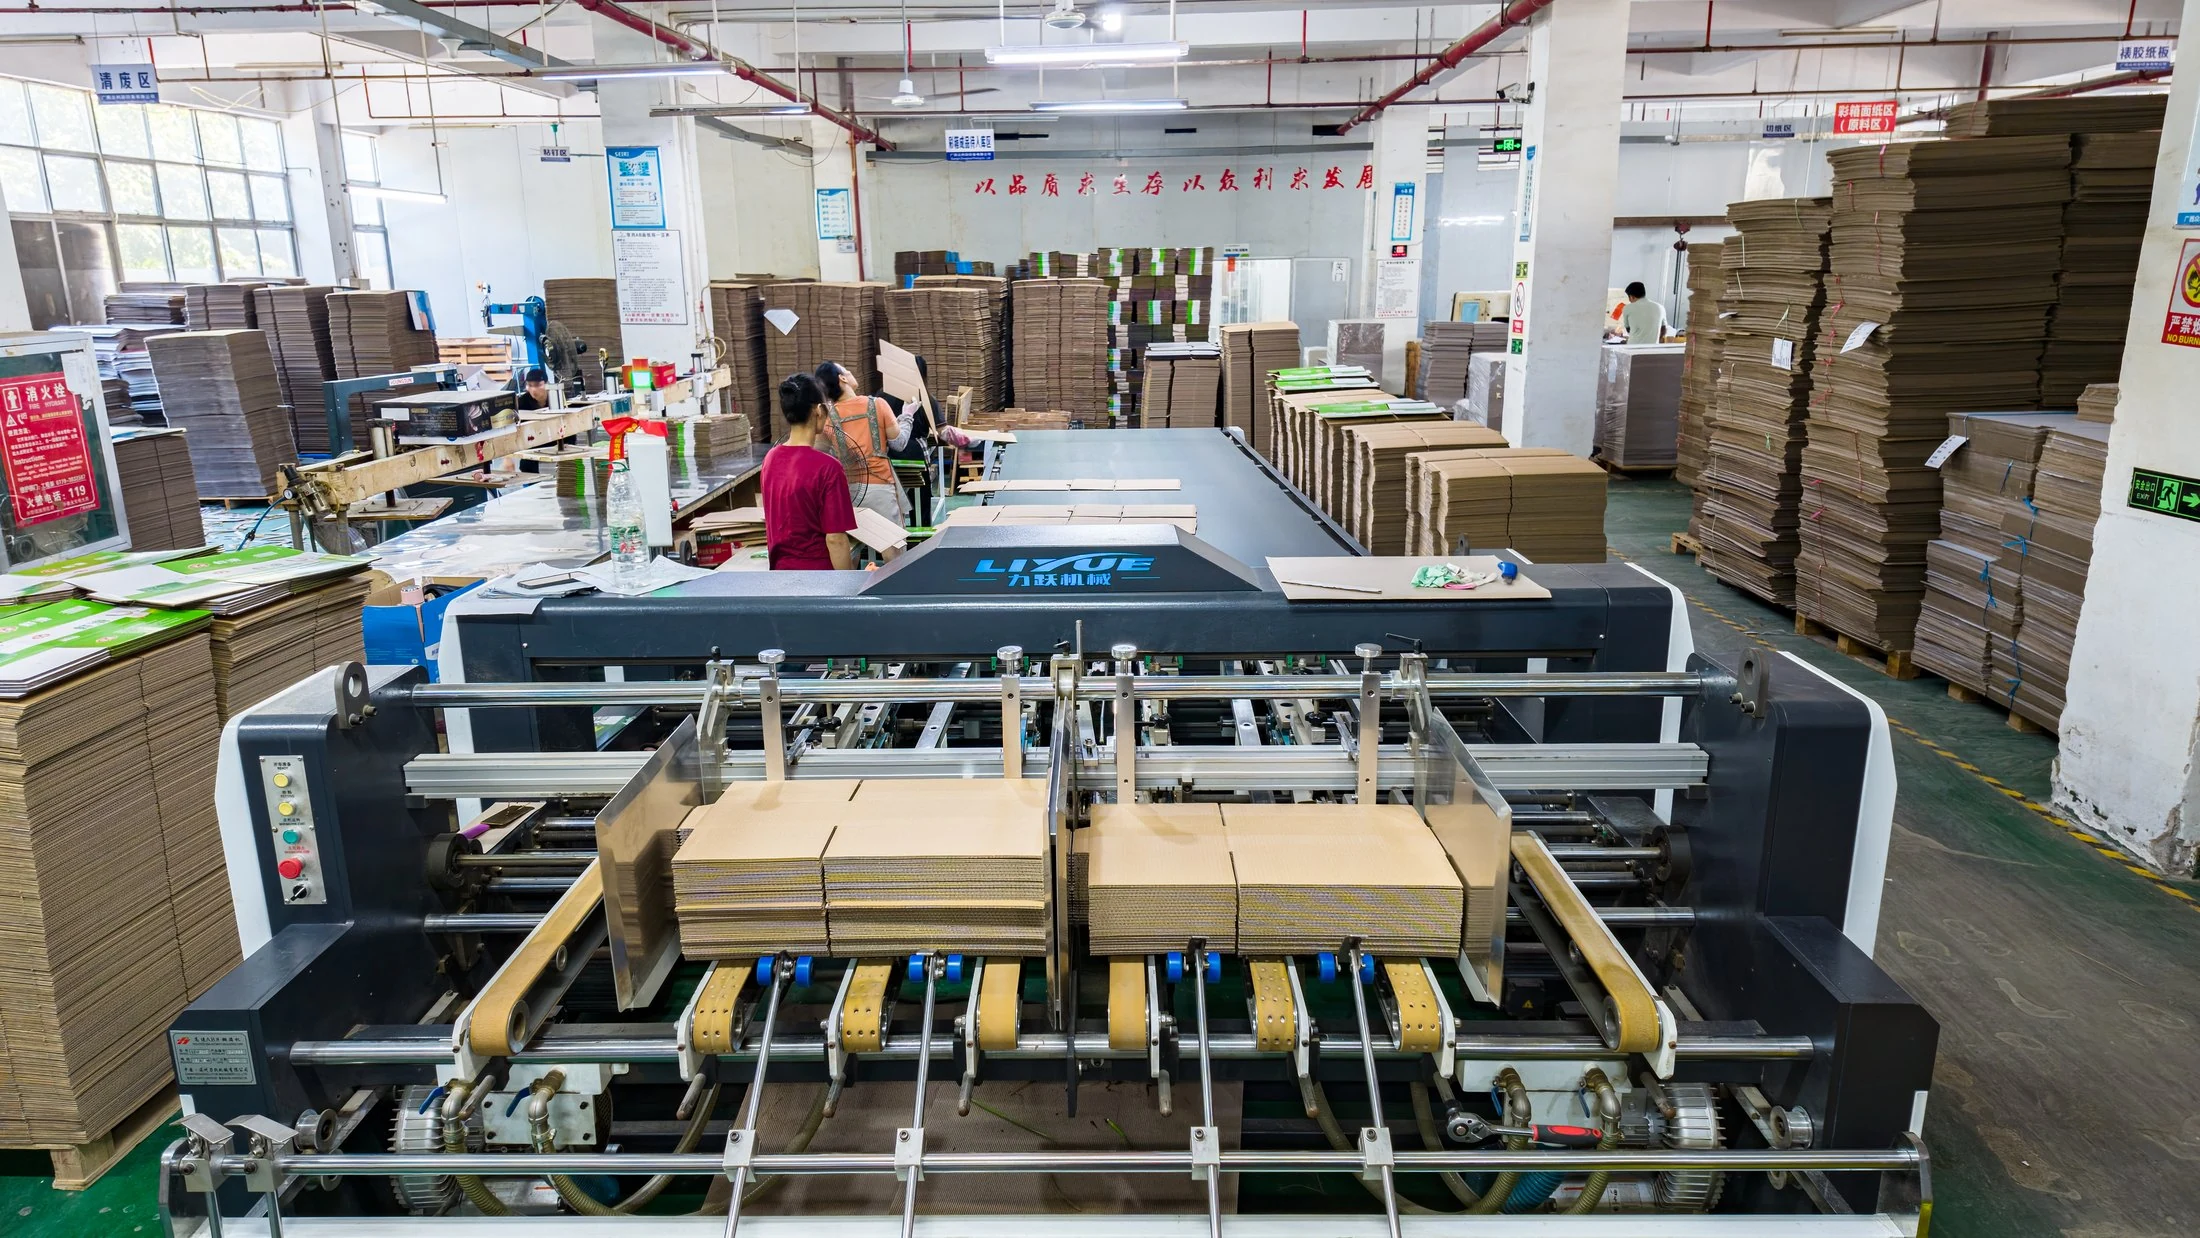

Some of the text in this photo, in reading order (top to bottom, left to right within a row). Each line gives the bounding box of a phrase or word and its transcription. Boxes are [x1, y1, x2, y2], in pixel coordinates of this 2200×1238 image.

[2120, 46, 2169, 59] 裱胶纸板
[99, 72, 151, 90] 清废区
[1838, 103, 1895, 118] 彩箱面纸区
[1766, 124, 1792, 132] 切纸区
[2184, 215, 2200, 224] 广西众
[2166, 333, 2178, 343] NO
[25, 382, 67, 402] 消火栓
[44, 399, 67, 408] HYDRANT
[67, 485, 86, 498] 119
[974, 552, 1156, 573] LIYUE
[1007, 573, 1112, 587] 力跃机械
